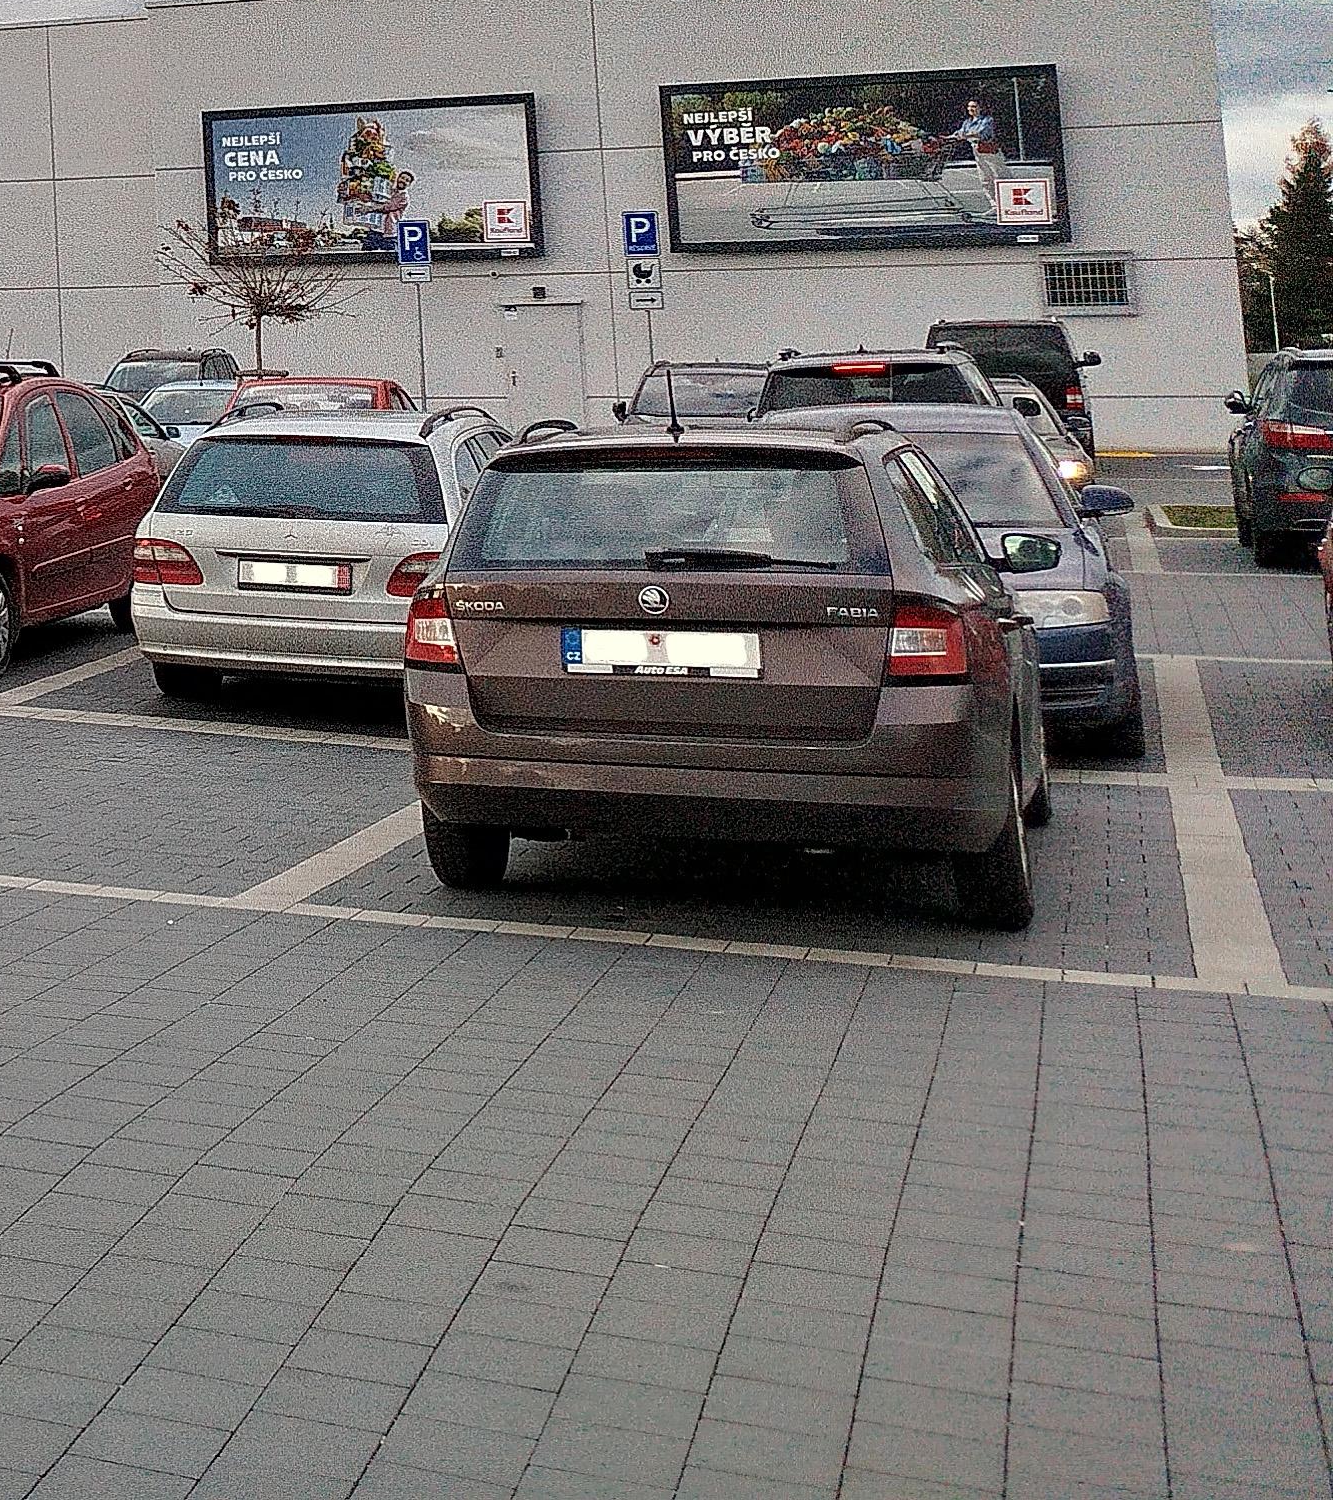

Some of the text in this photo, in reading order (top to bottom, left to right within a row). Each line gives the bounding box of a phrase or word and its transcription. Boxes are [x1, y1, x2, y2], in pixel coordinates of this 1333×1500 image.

[682, 106, 753, 124] NEJLEPŠÍ
[221, 131, 281, 147] NEJLEPŠÍ
[686, 122, 772, 147] VÝBĚR
[224, 149, 280, 167] CENA
[692, 146, 781, 162] PRO ČESKO
[228, 167, 303, 182] PRO ČESKO
[629, 217, 651, 243] P
[403, 226, 423, 251] P
[455, 599, 505, 611] ŠKODA
[826, 606, 879, 618] FABIA
[566, 651, 581, 660] CZ
[634, 665, 665, 675] Auto
[664, 666, 688, 675] ESA
